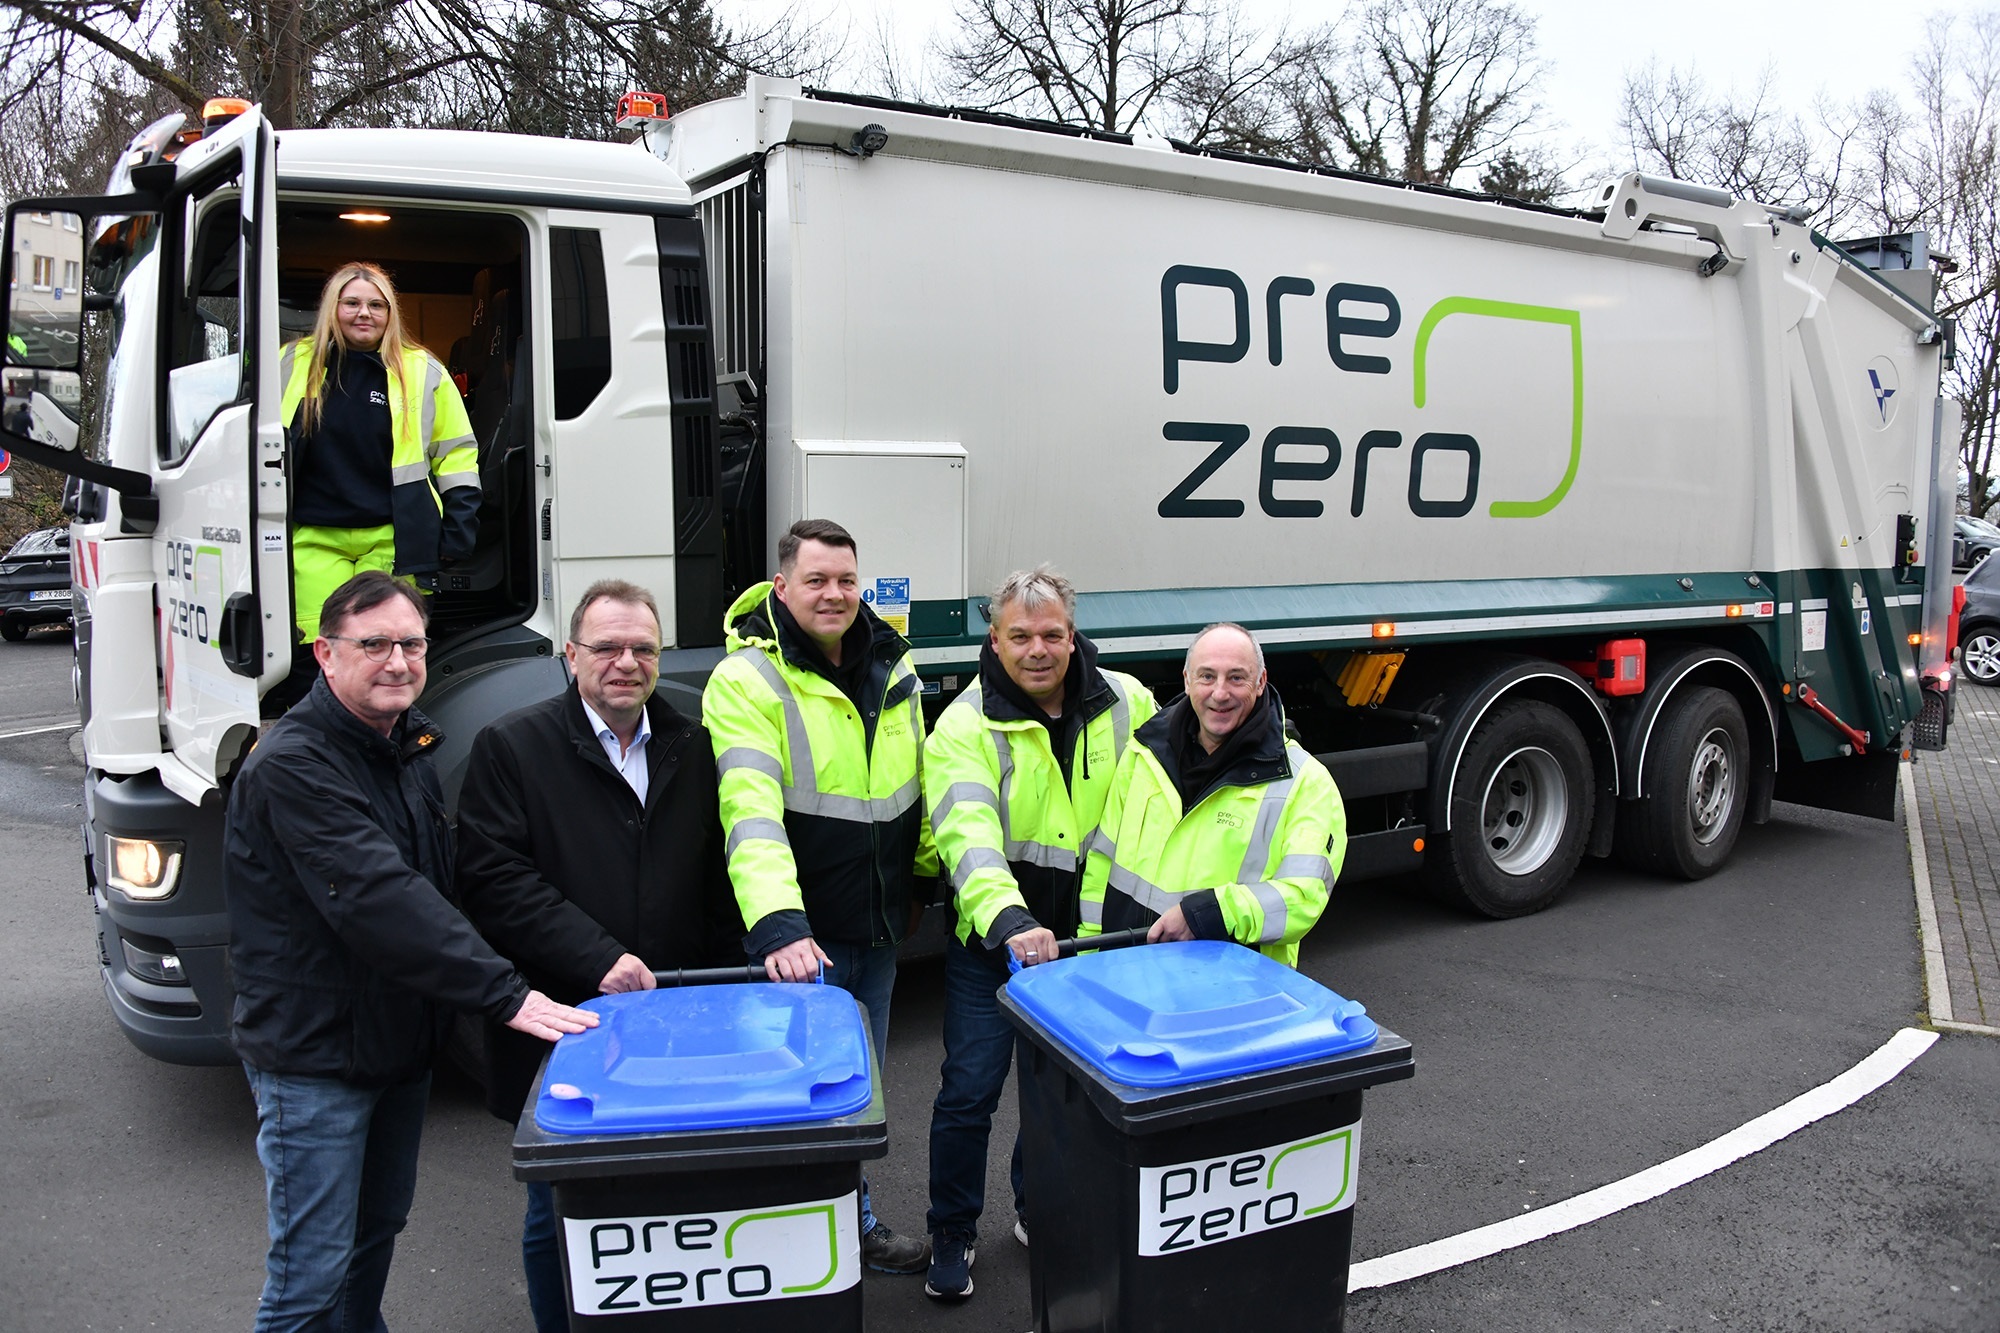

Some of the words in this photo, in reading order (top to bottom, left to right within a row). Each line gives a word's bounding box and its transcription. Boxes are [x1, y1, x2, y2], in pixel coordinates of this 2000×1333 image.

[1161, 264, 1401, 395] pre
[1158, 421, 1481, 519] zero
[167, 540, 193, 587] pre
[169, 597, 209, 645] zero
[1159, 1154, 1266, 1214] pre
[590, 1218, 718, 1270] pre
[1158, 1191, 1299, 1252] zero
[594, 1264, 772, 1310] zero
